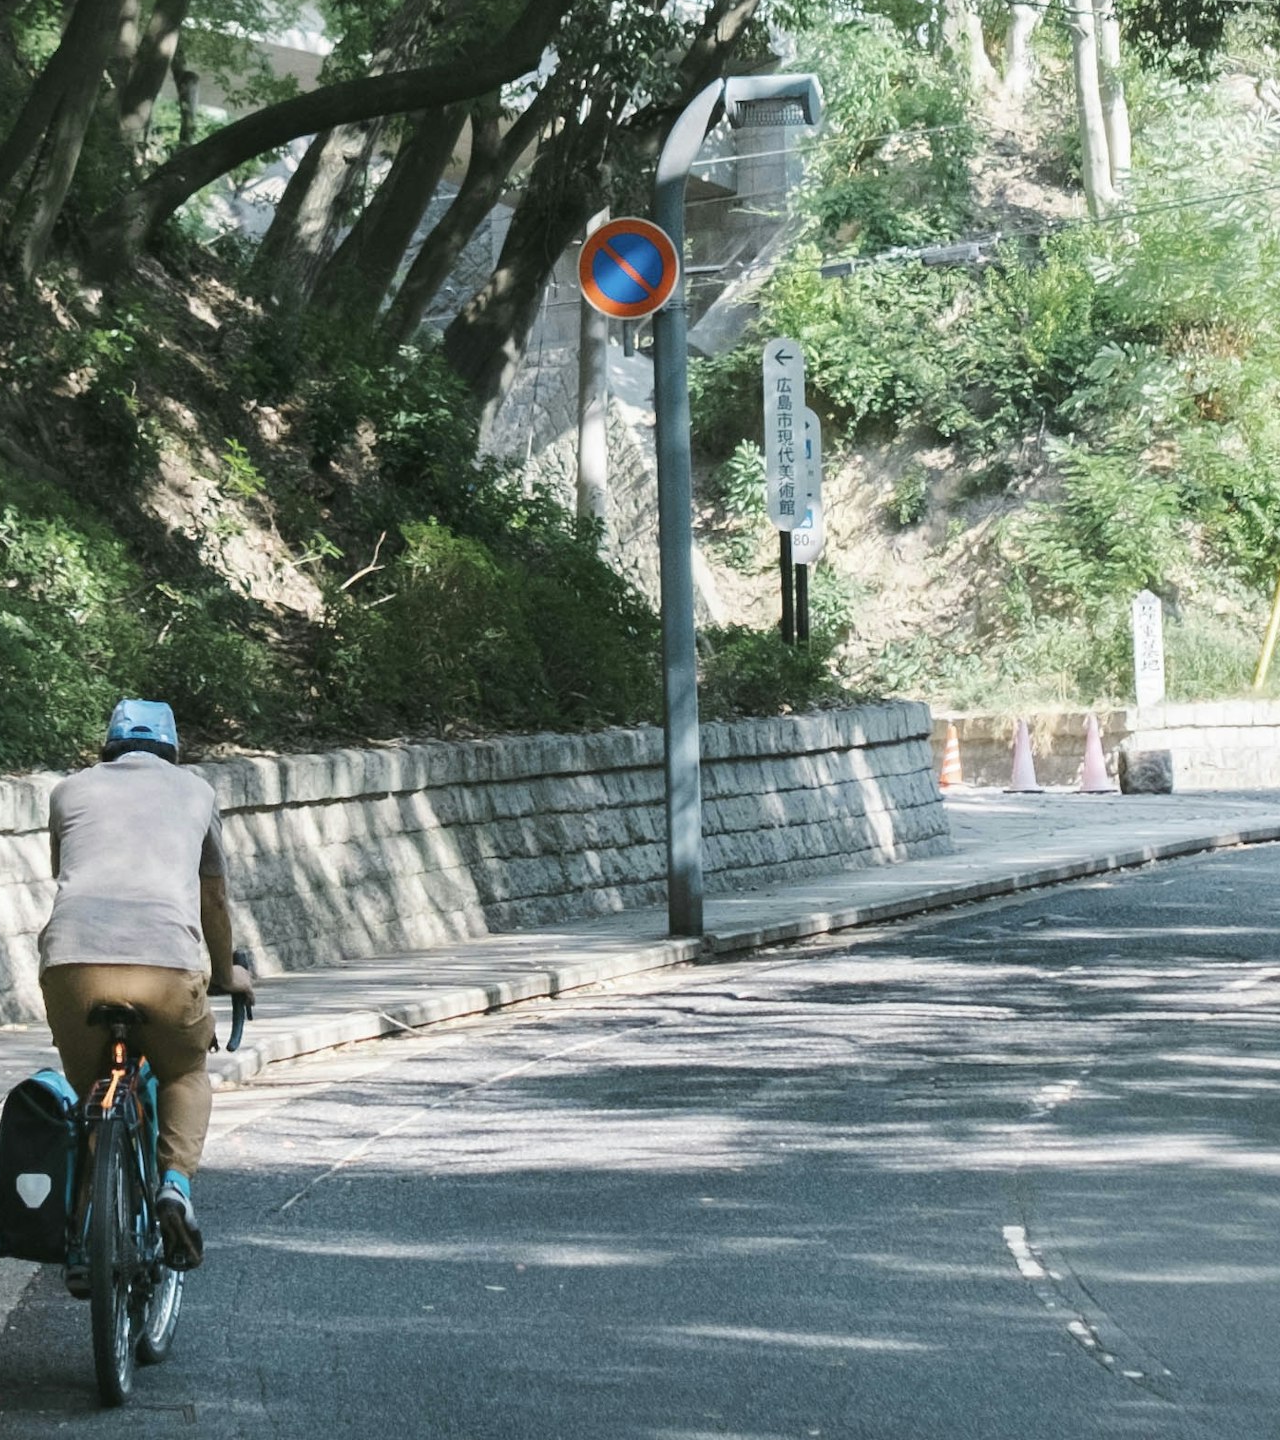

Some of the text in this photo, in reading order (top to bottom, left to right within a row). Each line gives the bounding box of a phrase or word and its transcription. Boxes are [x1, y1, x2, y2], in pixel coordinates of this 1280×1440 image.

[777, 377, 795, 515] 広島市現代美術館
